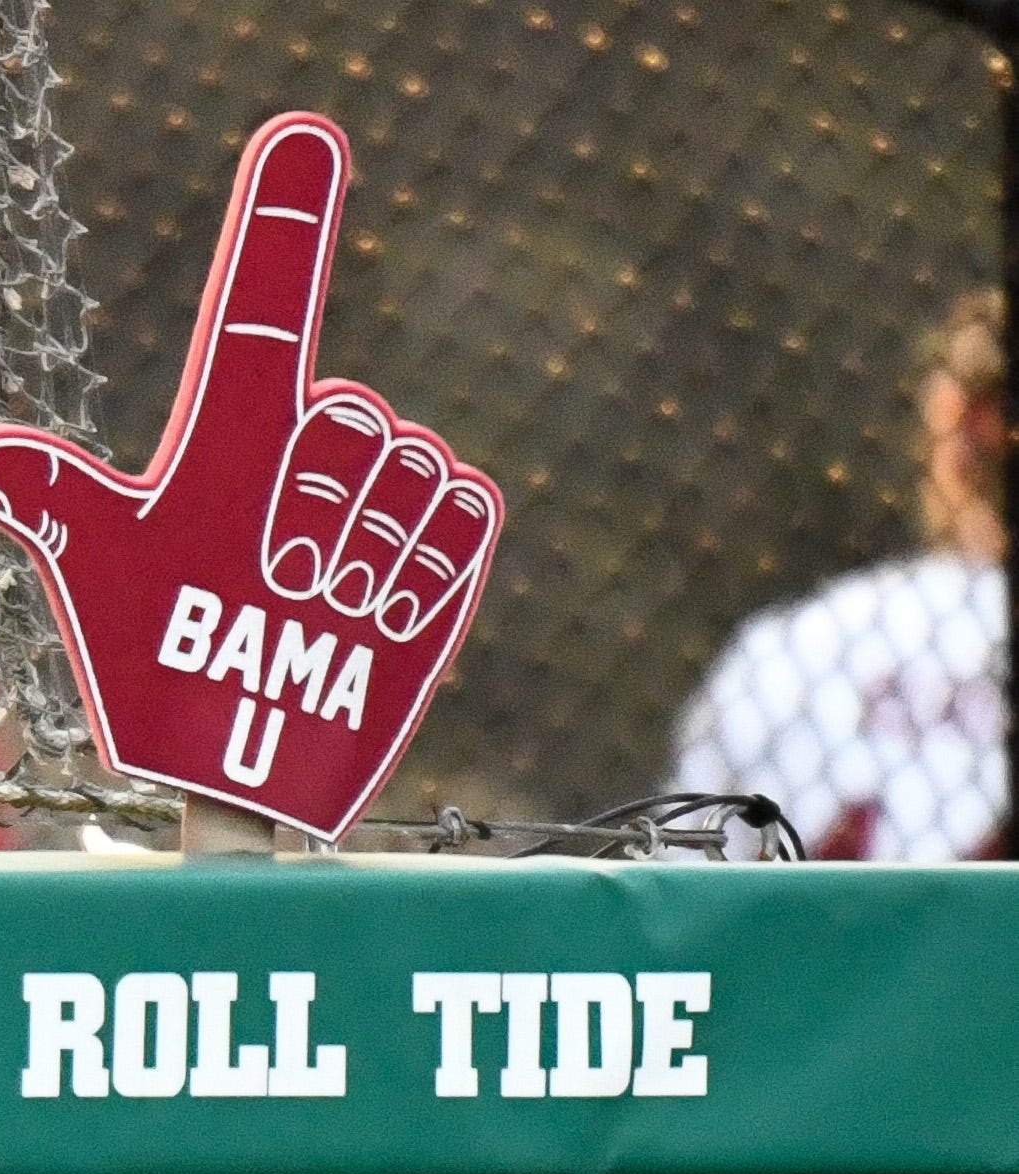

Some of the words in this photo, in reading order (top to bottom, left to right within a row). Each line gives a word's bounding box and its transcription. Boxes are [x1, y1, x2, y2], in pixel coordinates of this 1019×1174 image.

[157, 584, 375, 731] BAMA
[222, 696, 286, 788] U
[21, 971, 348, 1098] ROLL
[412, 971, 713, 1098] TIDE
